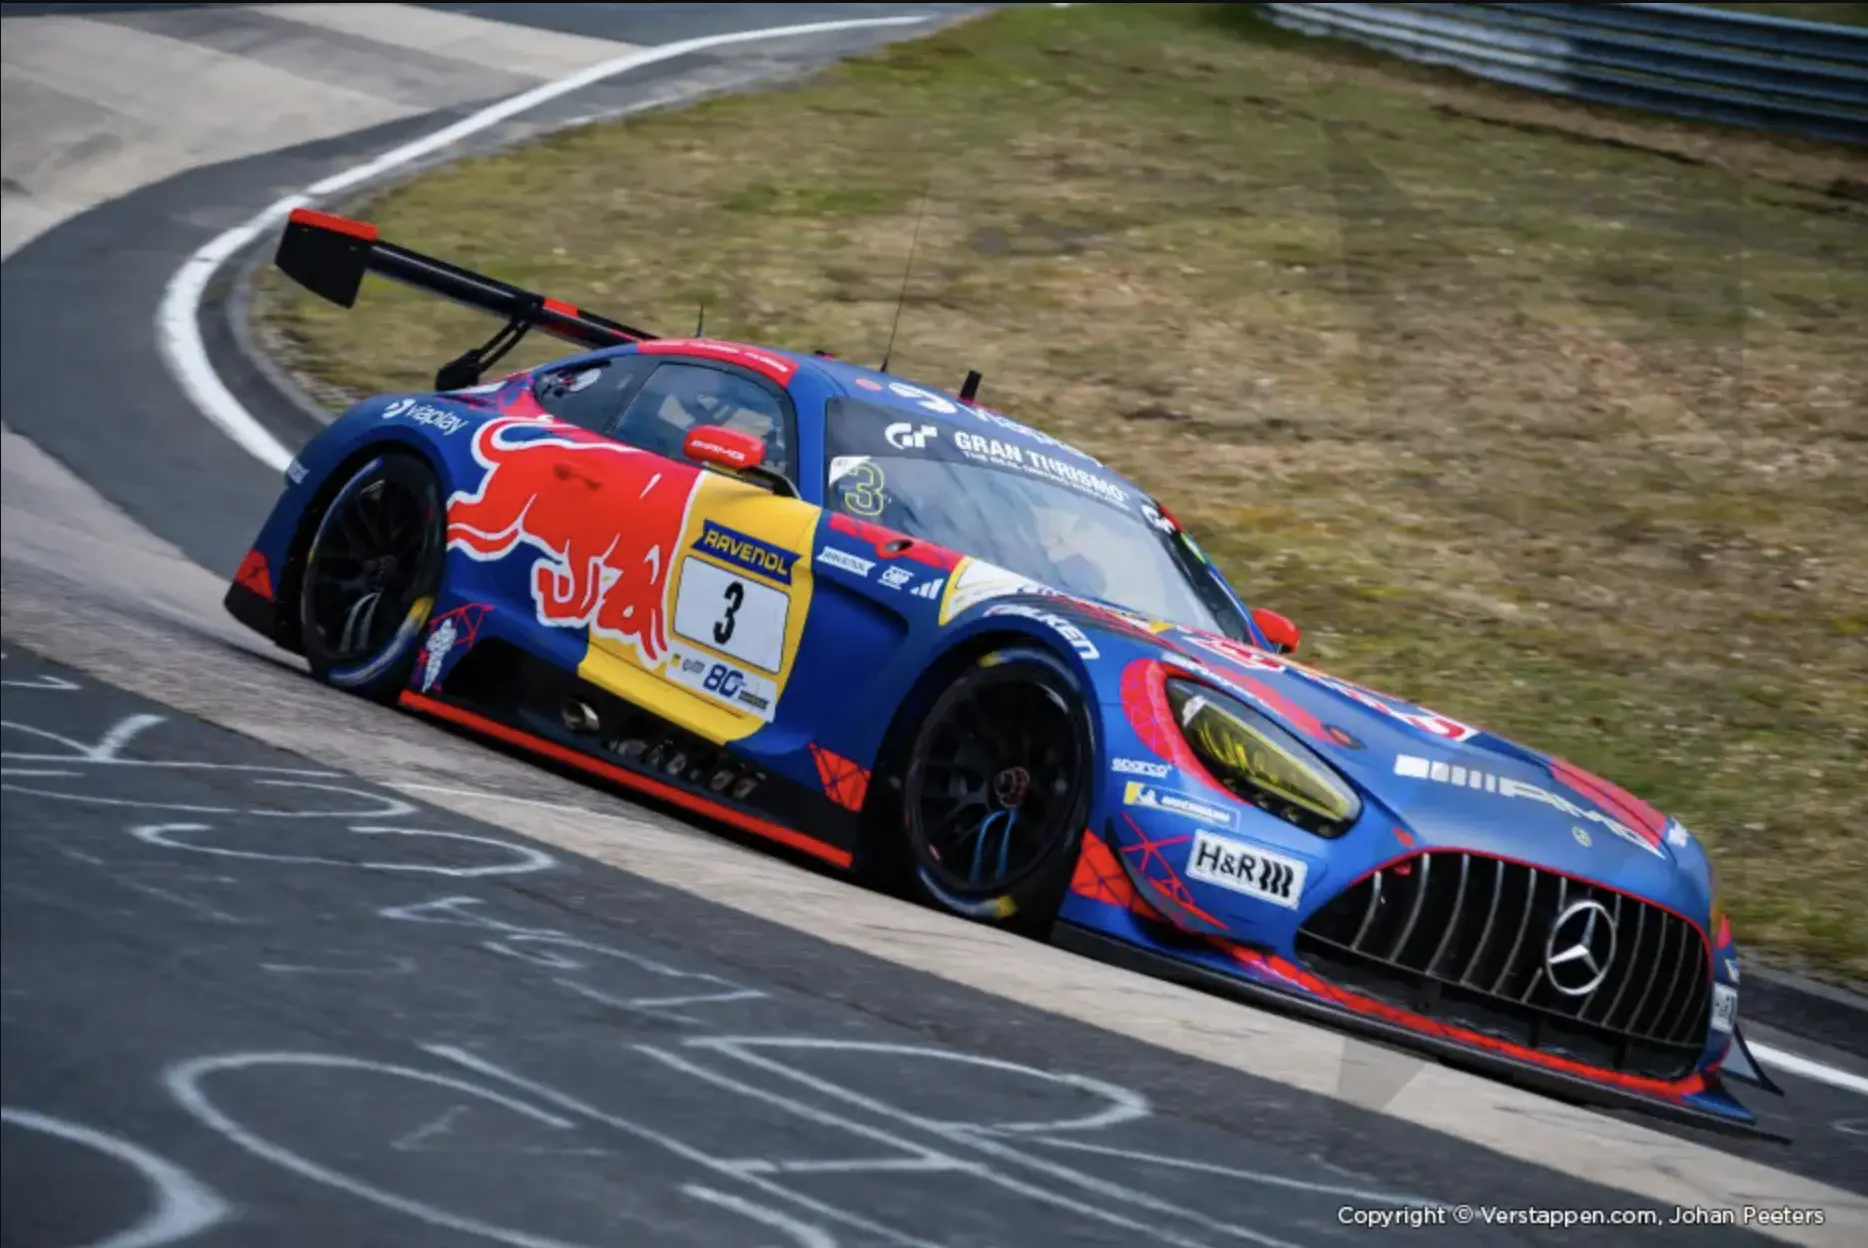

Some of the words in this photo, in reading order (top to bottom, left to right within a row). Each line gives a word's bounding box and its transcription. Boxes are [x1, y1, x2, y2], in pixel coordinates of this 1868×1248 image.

[954, 431, 1023, 463] GRAN
[844, 460, 885, 516] 3
[704, 530, 788, 575] RAVENOL
[713, 580, 744, 645] 3
[703, 663, 744, 698] 80
[1196, 840, 1257, 883] H&R
